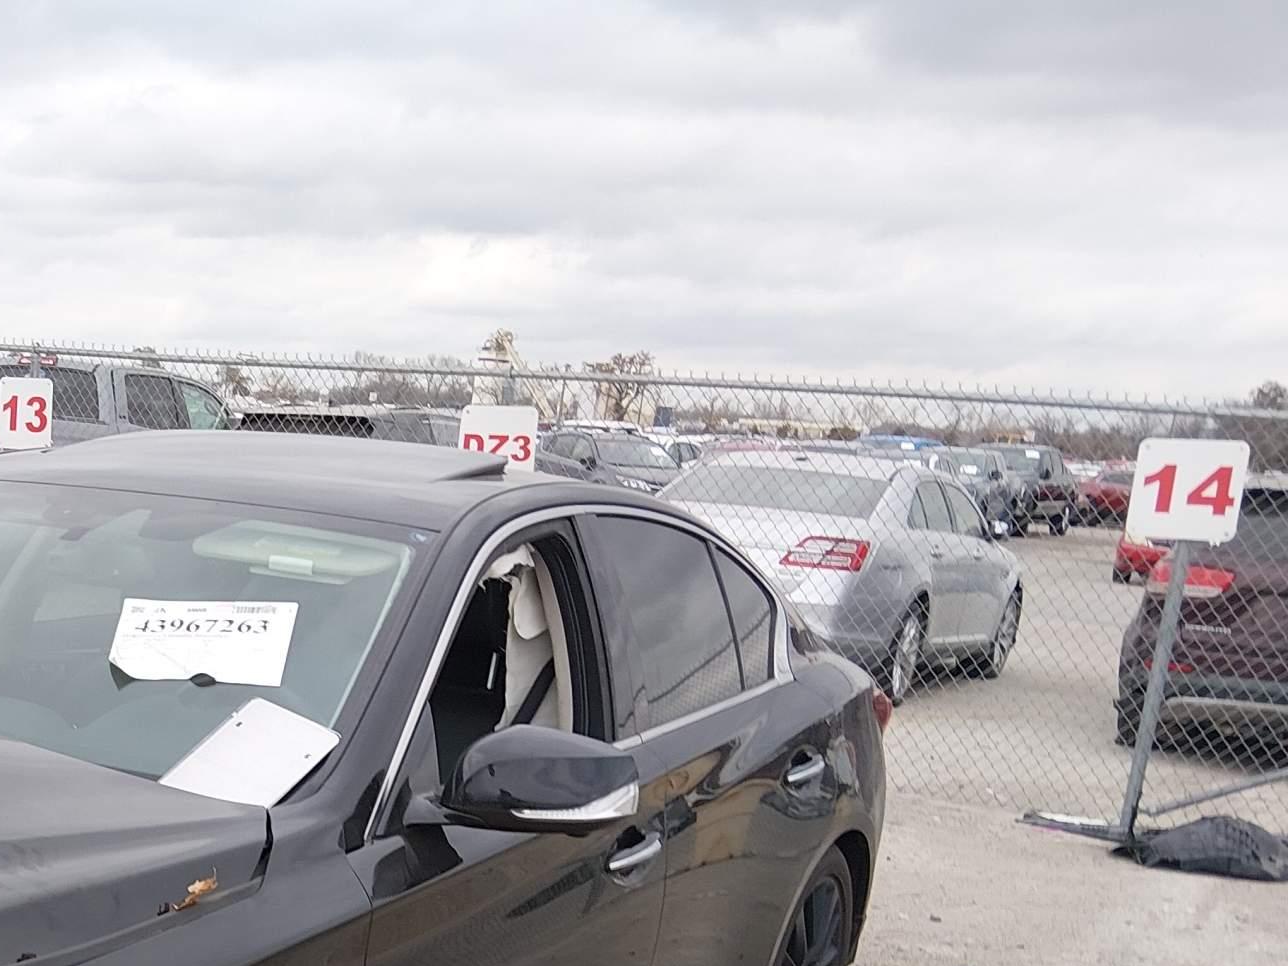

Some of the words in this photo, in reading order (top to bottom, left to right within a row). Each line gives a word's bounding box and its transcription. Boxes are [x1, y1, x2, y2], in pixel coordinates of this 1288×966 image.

[3, 395, 48, 434] 13
[462, 433, 532, 462] DZ3
[1143, 463, 1236, 516] 14
[134, 619, 270, 634] 43967263
